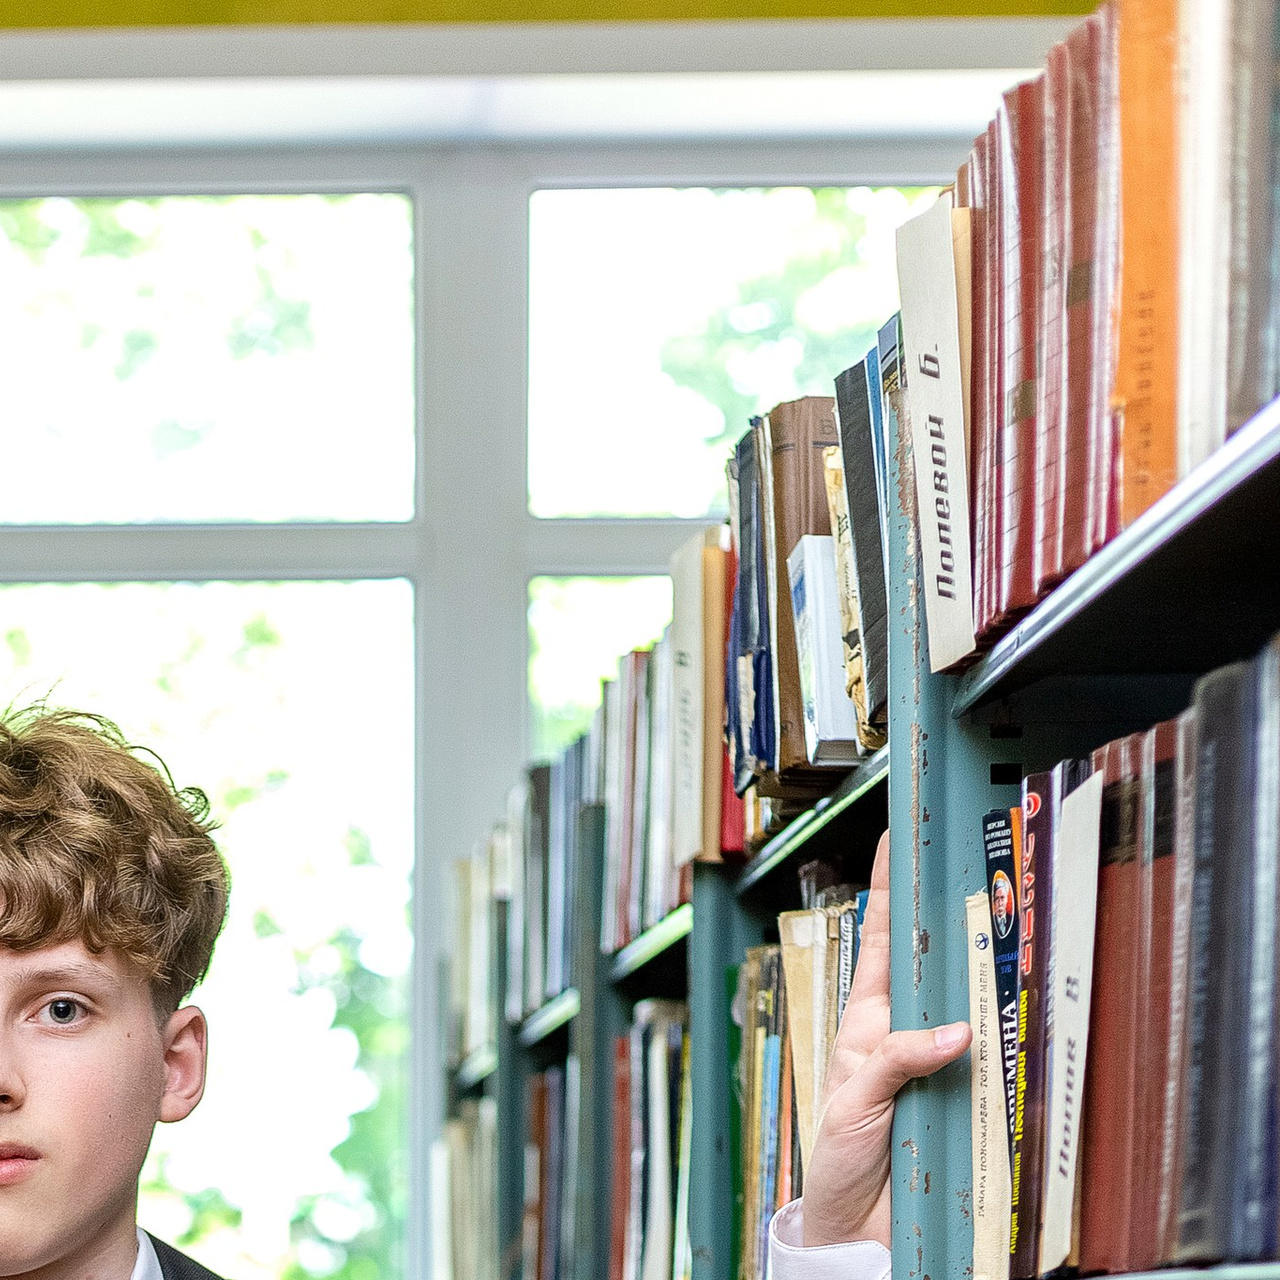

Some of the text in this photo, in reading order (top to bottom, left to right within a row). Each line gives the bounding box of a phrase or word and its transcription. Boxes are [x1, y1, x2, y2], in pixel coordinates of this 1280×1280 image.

[918, 344, 956, 601] Полевой Б.
[979, 962, 989, 993] МЕНЯ
[979, 996, 989, 1037] ЛУЧШЕ
[979, 1040, 988, 1062] КТО
[1058, 1036, 1076, 1179] Попов
[978, 1175, 987, 1218] ТАМАРА
